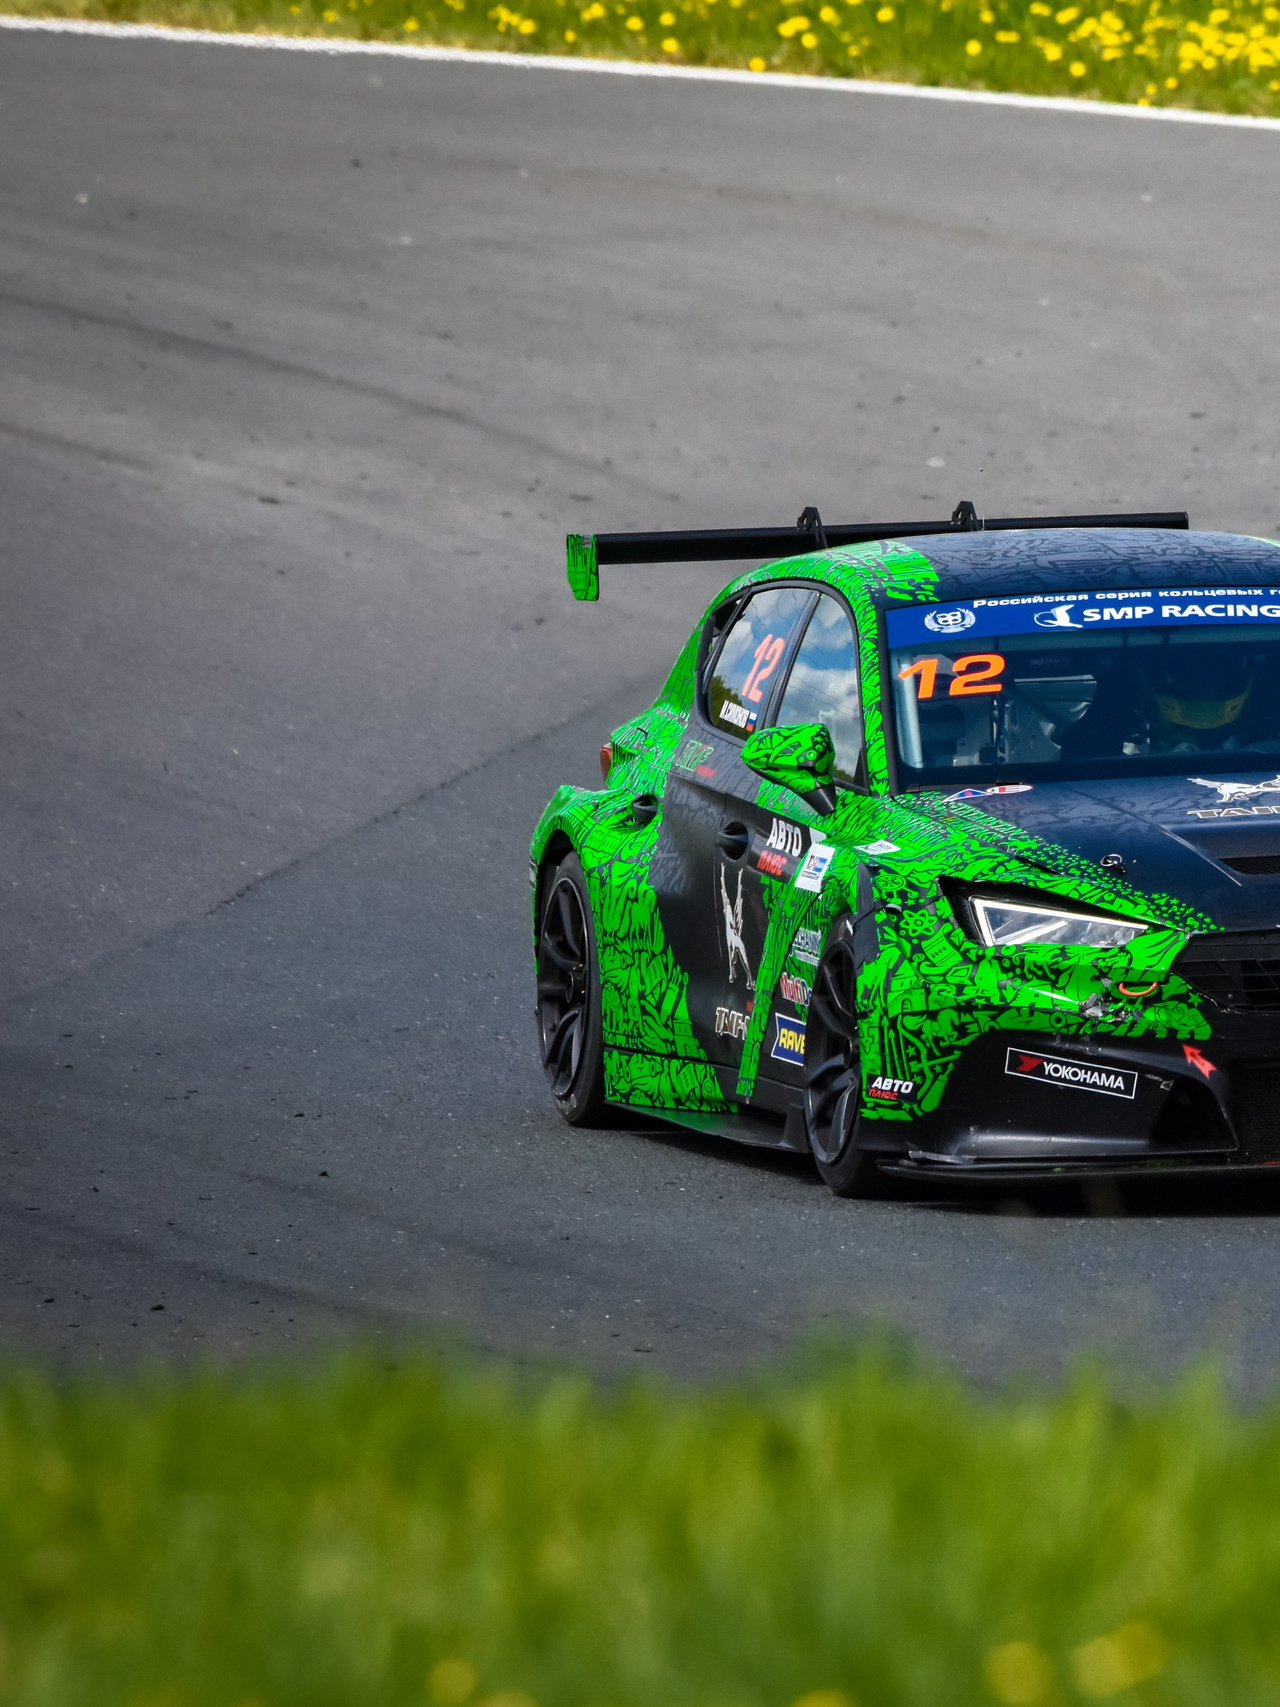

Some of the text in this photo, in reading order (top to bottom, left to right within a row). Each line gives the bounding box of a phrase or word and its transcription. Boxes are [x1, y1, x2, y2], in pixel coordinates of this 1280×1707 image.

[973, 593, 1089, 609] Российская
[1095, 591, 1152, 601] серия
[1158, 588, 1264, 598] кольцевых
[1082, 605, 1155, 623] SMP
[742, 633, 786, 703] 12
[897, 653, 1006, 700] 12
[766, 817, 803, 857] АВТО
[871, 1076, 914, 1094] АВТО
[1043, 1061, 1125, 1090] YOKOHAMA
